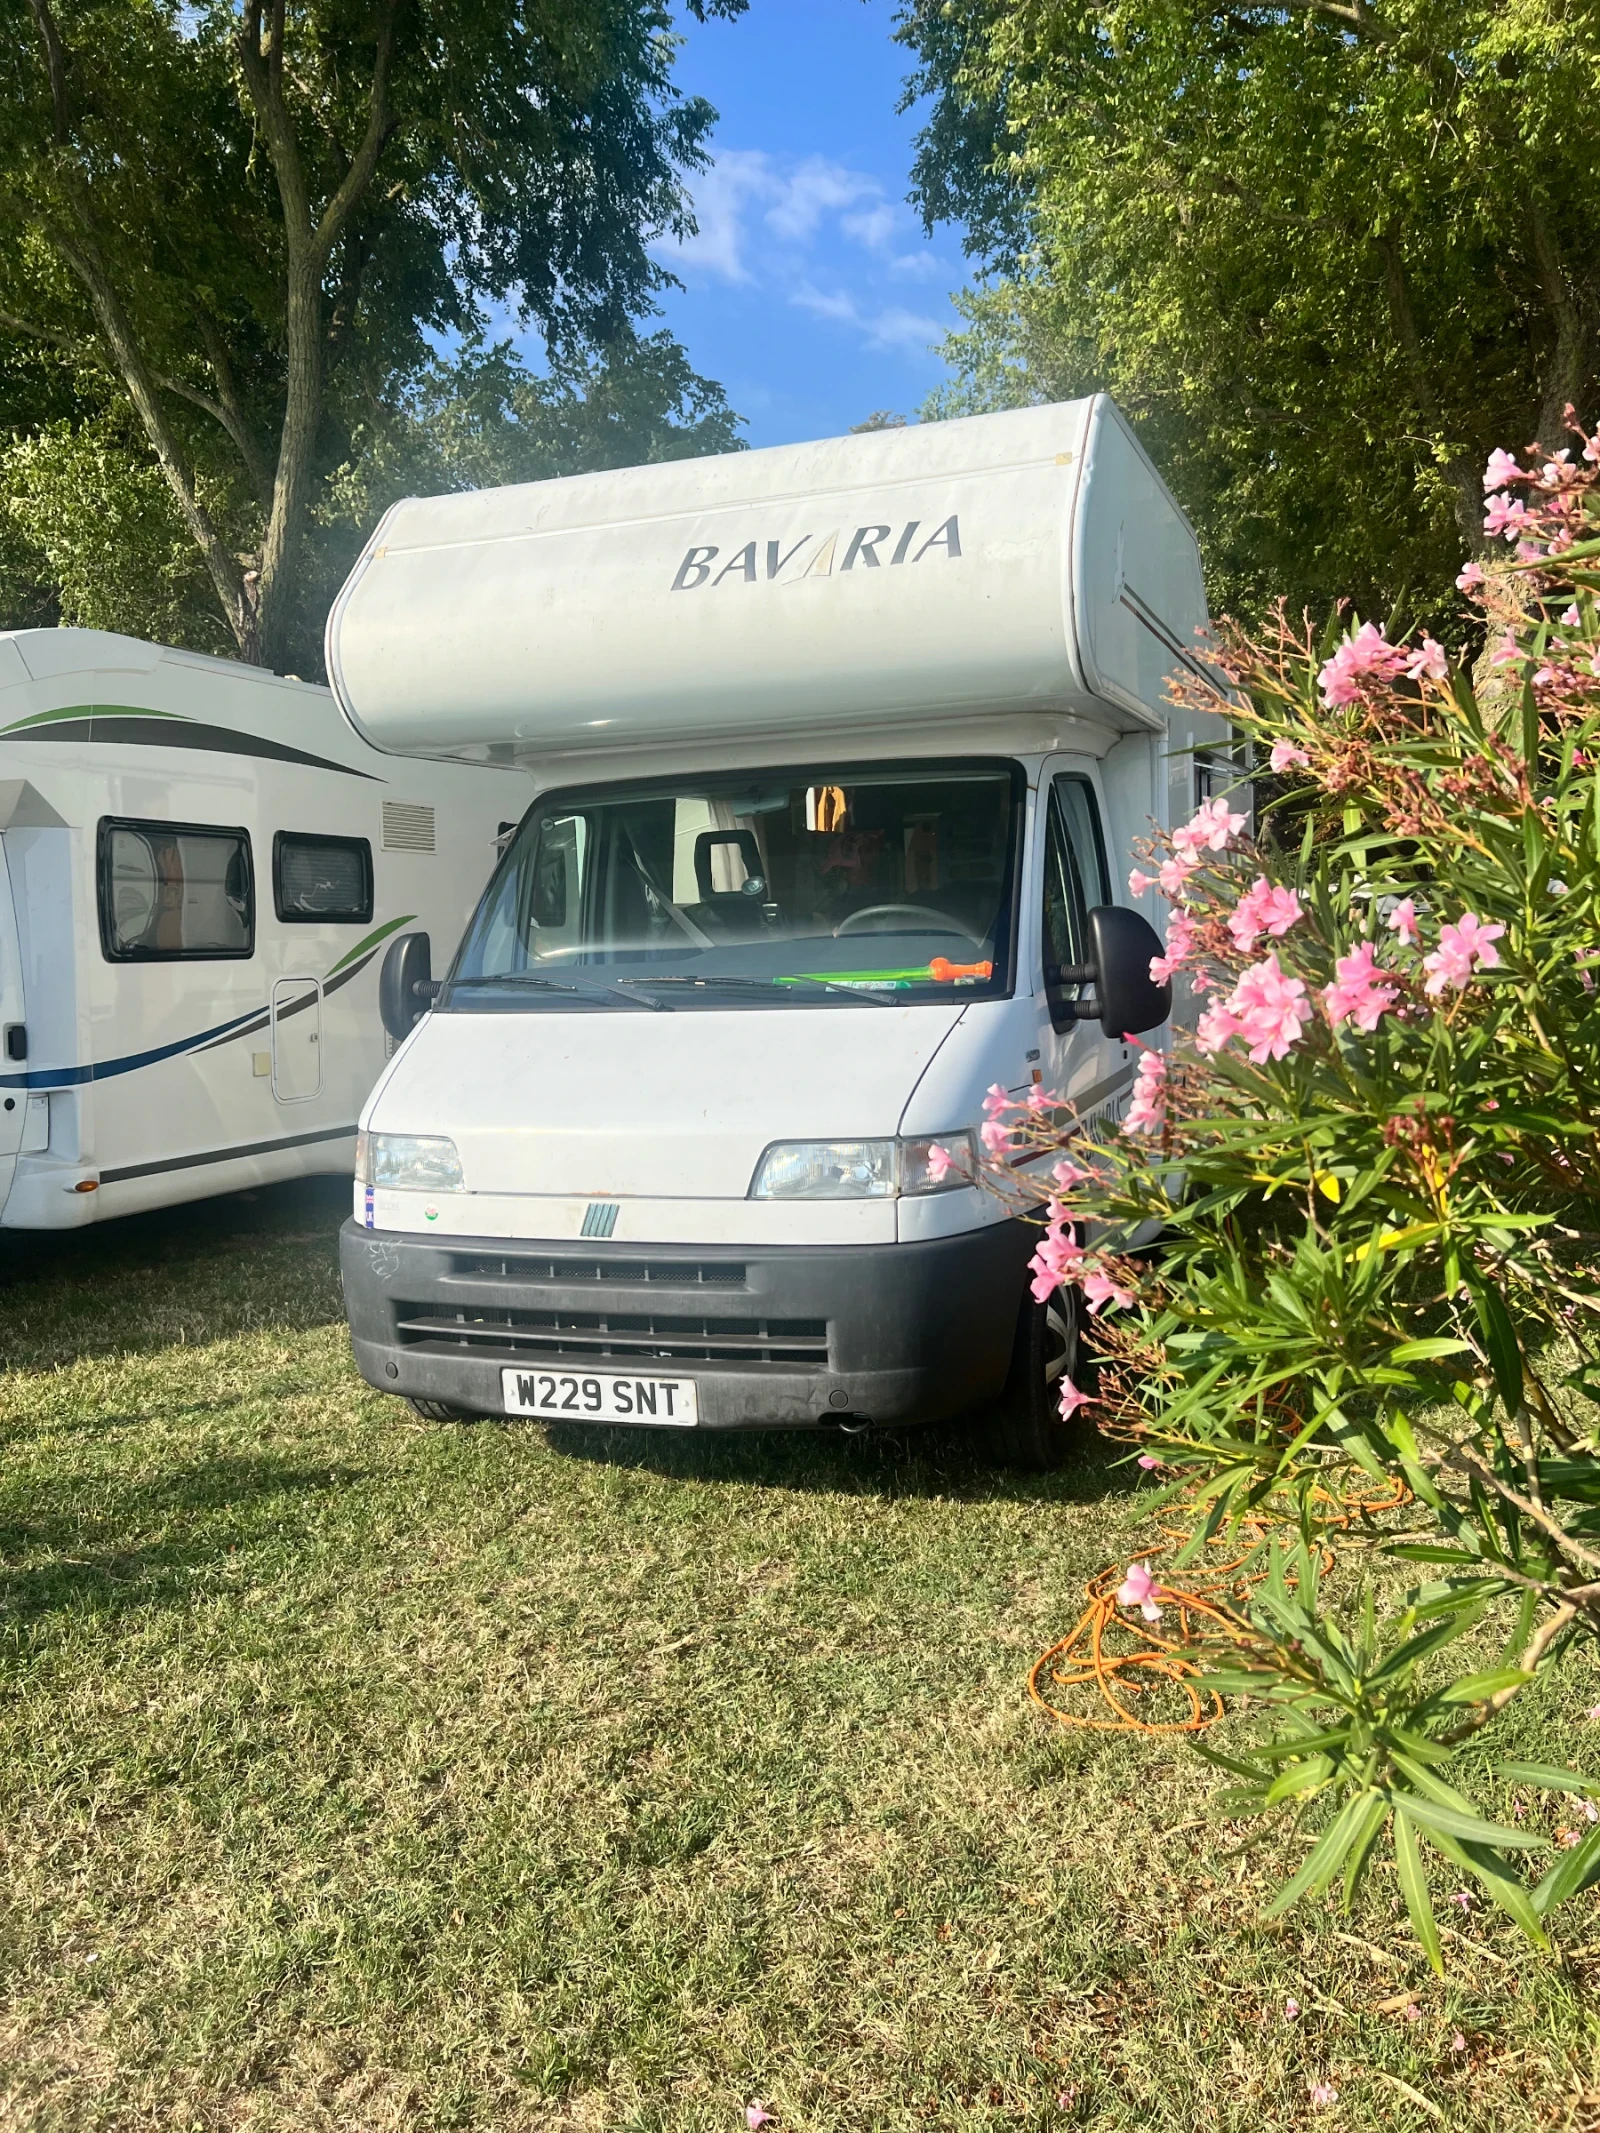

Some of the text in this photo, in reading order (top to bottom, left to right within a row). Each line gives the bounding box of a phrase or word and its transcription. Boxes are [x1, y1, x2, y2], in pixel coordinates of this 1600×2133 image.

[669, 514, 962, 592] BAVARIA
[516, 1374, 679, 1417] W229 SNT
